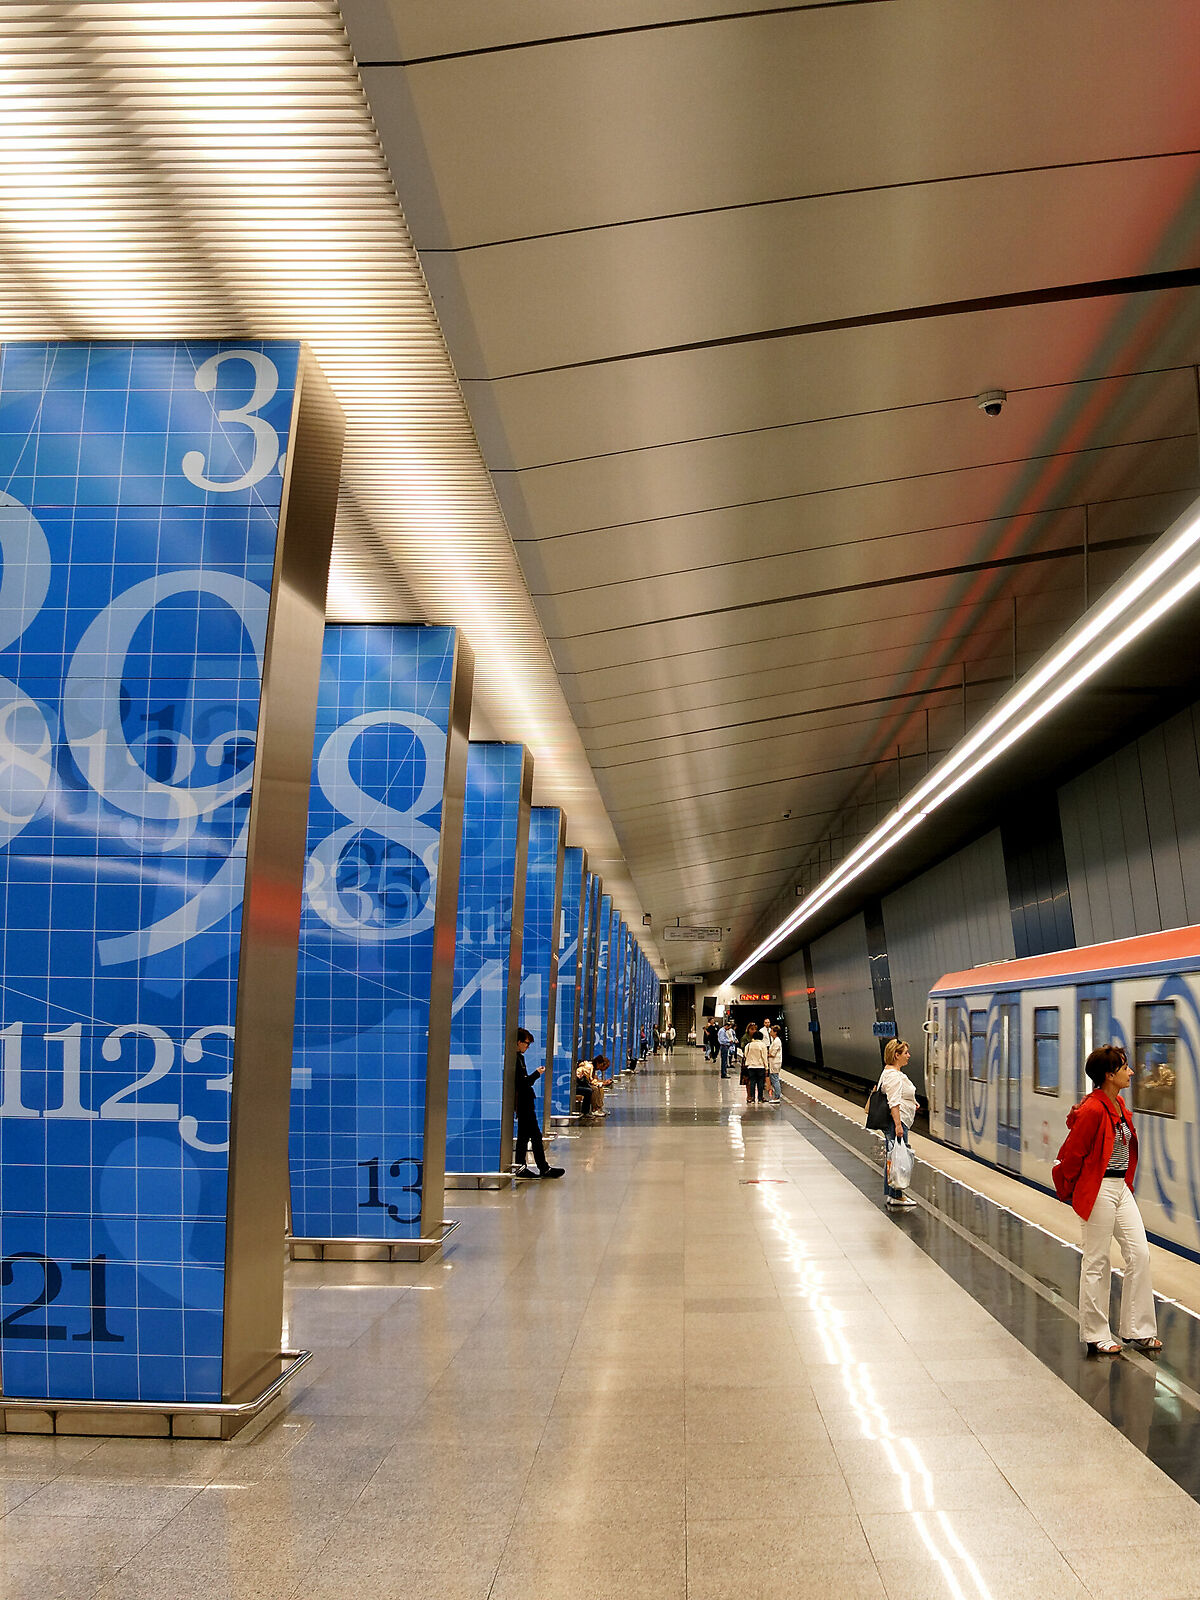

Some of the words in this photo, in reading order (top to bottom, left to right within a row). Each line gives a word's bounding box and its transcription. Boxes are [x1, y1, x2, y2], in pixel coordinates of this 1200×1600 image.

[182, 350, 280, 492] 3
[63, 569, 271, 967] 9
[317, 710, 447, 939] 8
[357, 1156, 423, 1224] 13
[0, 1250, 125, 1342] 21
